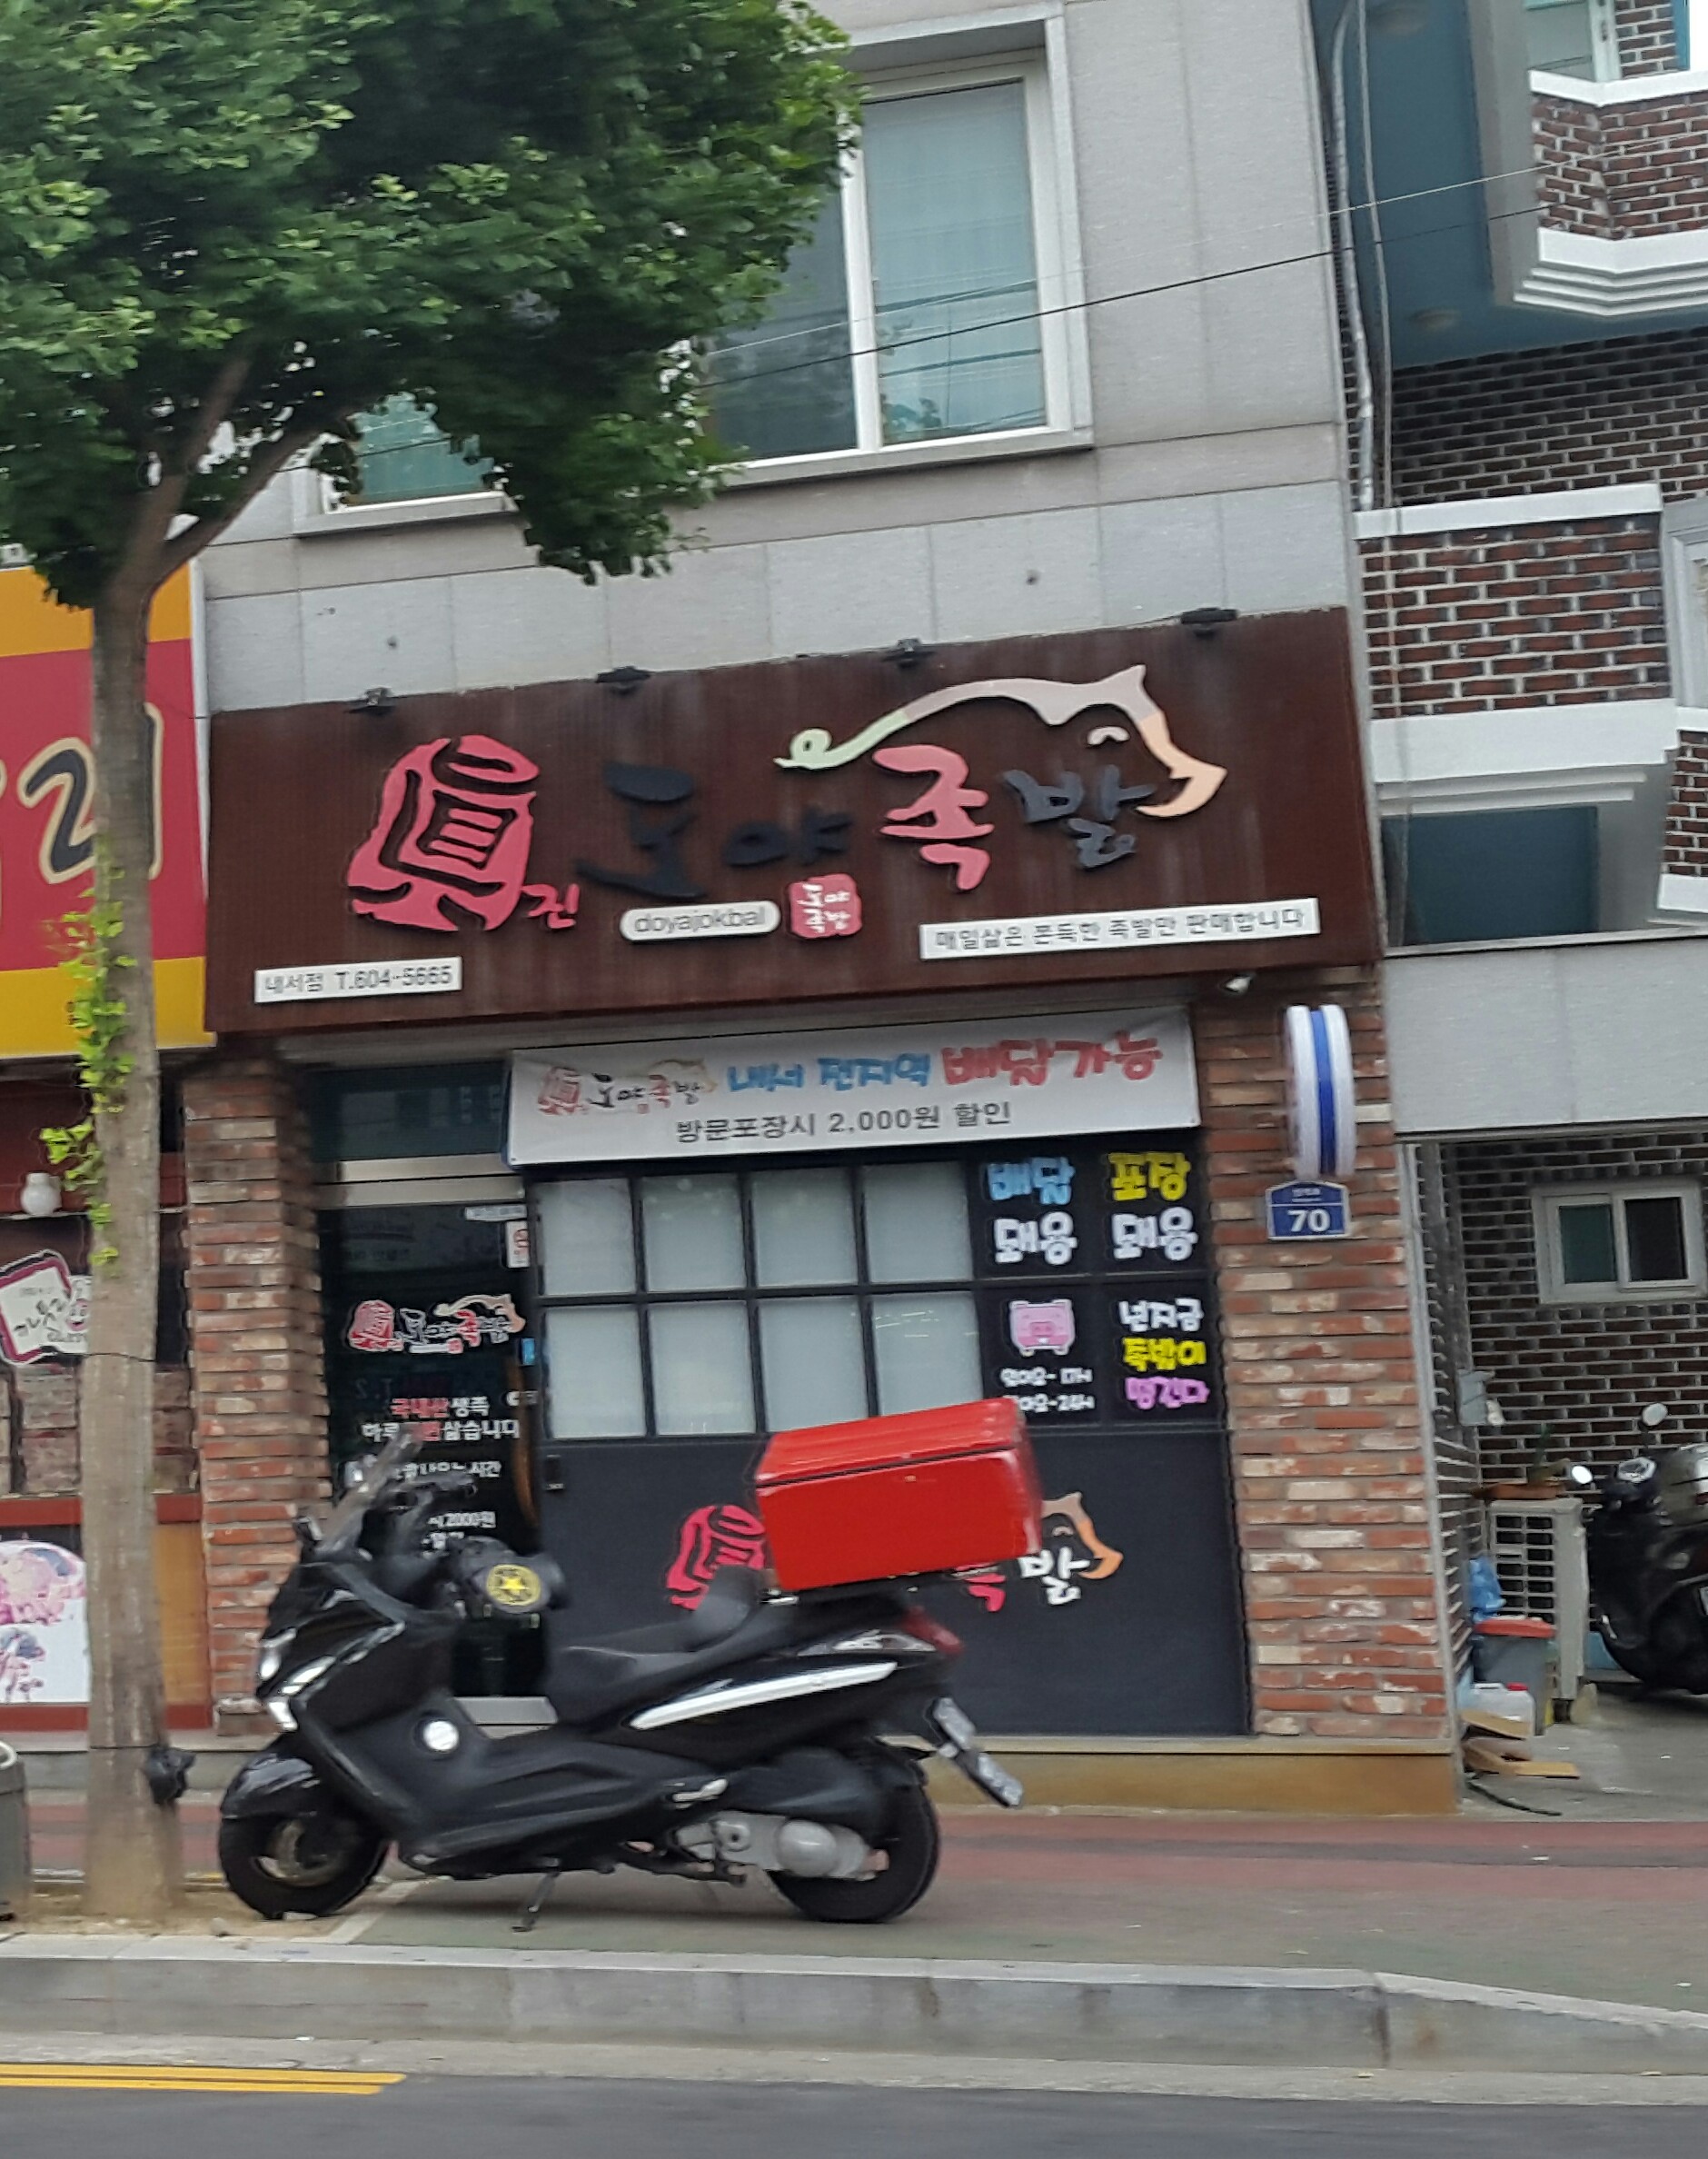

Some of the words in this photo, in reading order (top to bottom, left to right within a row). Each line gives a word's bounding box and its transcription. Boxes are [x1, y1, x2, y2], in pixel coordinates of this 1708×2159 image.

[1108, 917, 1177, 939] 족발만
[1186, 909, 1304, 935] 판매합니다
[264, 972, 323, 994] 내서점
[941, 1030, 1163, 1086] 배달가능
[677, 1112, 815, 1143] 방문포장시
[952, 1101, 1010, 1127] 할인
[1286, 1209, 1331, 1232] 70
